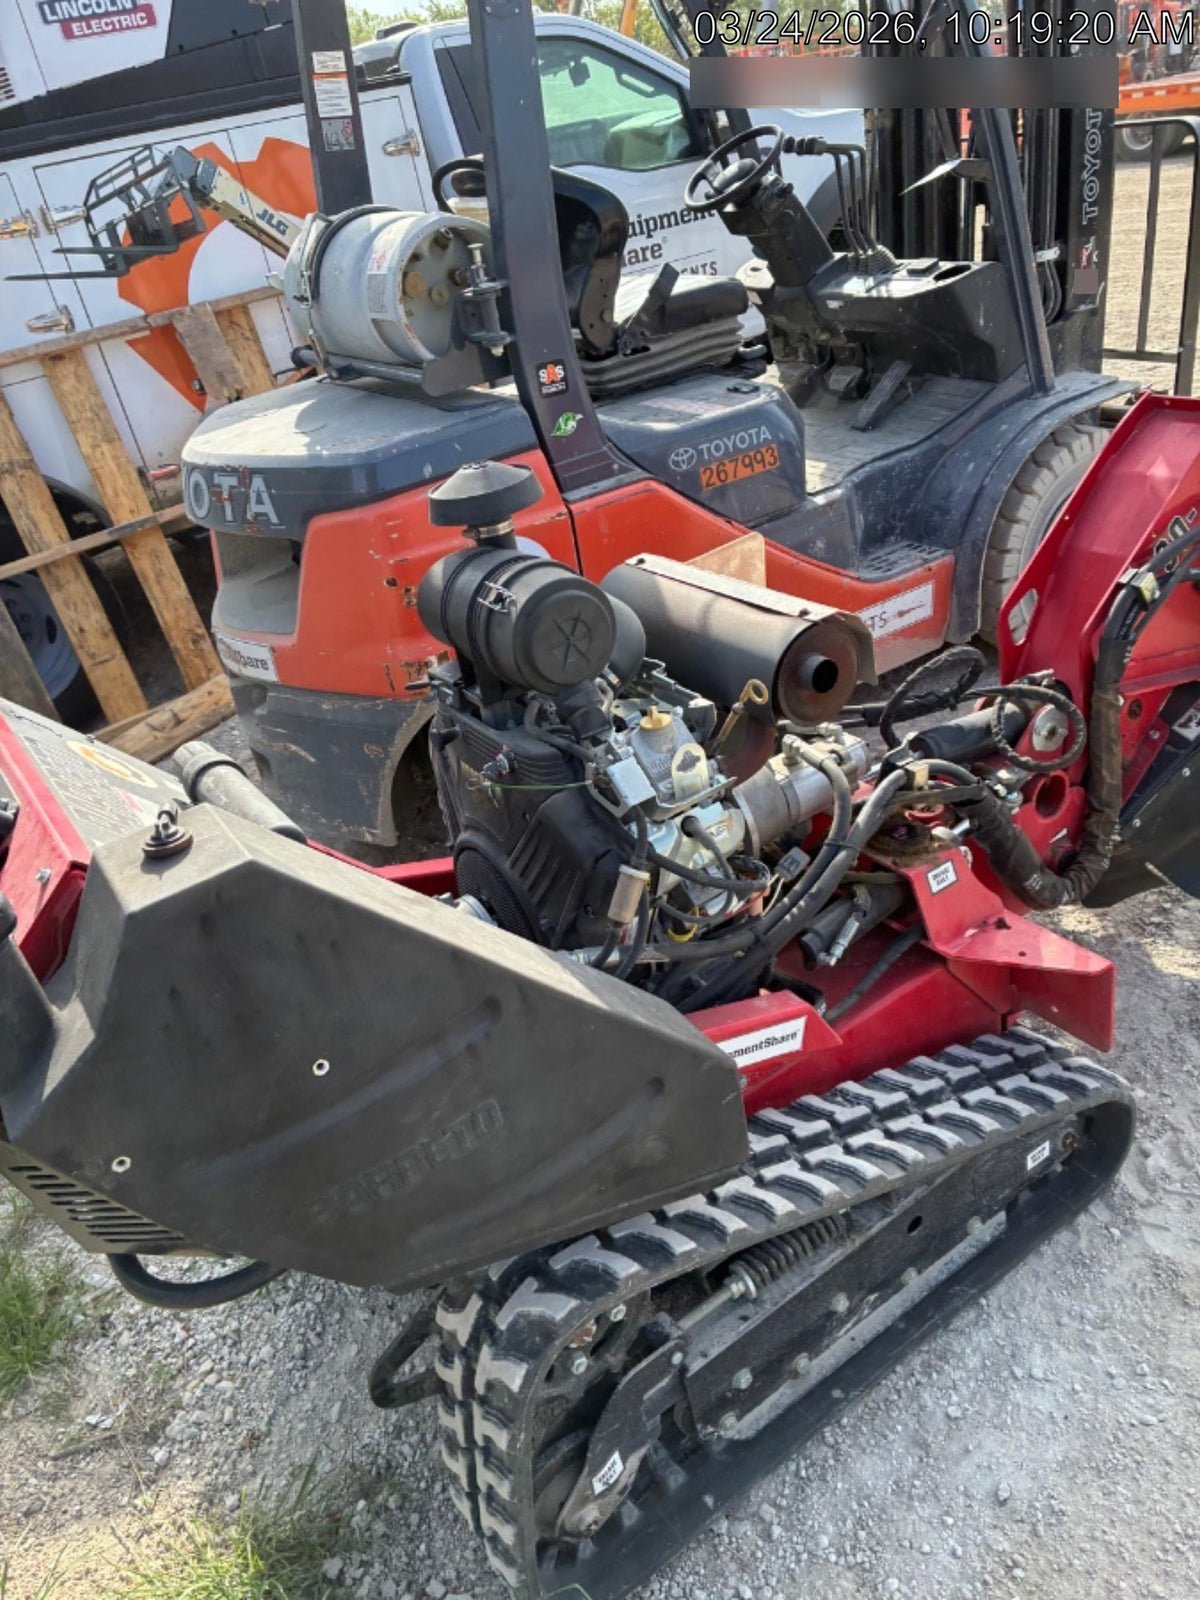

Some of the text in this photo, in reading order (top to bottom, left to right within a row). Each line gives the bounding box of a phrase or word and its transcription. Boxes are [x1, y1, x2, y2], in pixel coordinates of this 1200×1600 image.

[43, 0, 134, 21] LINCOLN
[71, 12, 148, 36] ELECTRIC
[256, 208, 289, 237] JLG
[621, 242, 664, 267] are
[698, 426, 772, 459] TOYOTA
[702, 446, 778, 488] 267993
